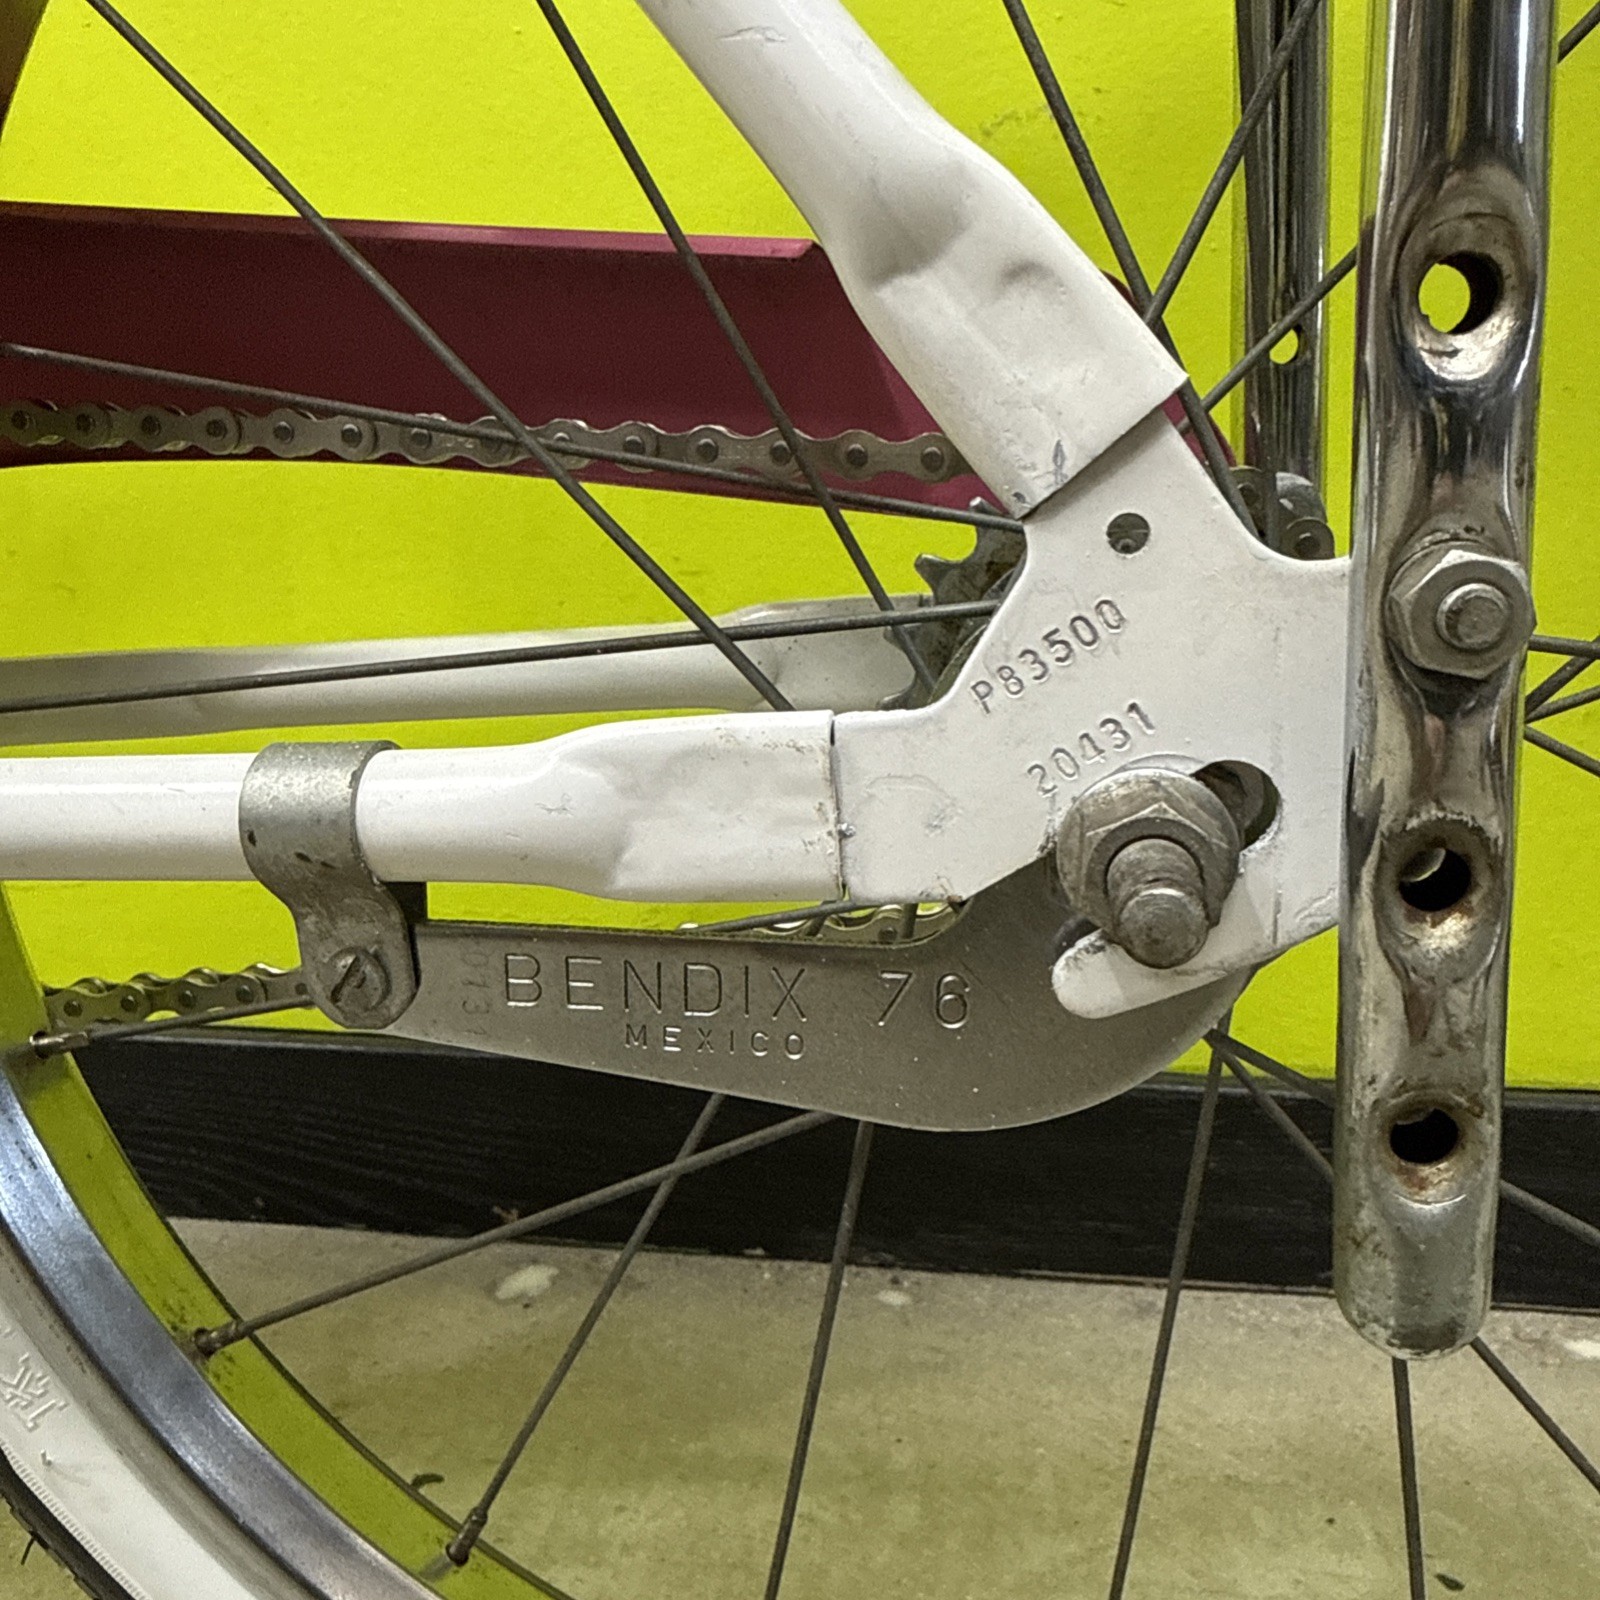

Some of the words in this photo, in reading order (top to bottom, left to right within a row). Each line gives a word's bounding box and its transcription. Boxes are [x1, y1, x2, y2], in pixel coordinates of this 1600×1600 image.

[970, 599, 1126, 714] P83500
[1027, 702, 1155, 796] 20431
[503, 952, 808, 1022] BENDIX
[877, 968, 972, 1030] 76
[624, 1023, 807, 1060] MEXICO
